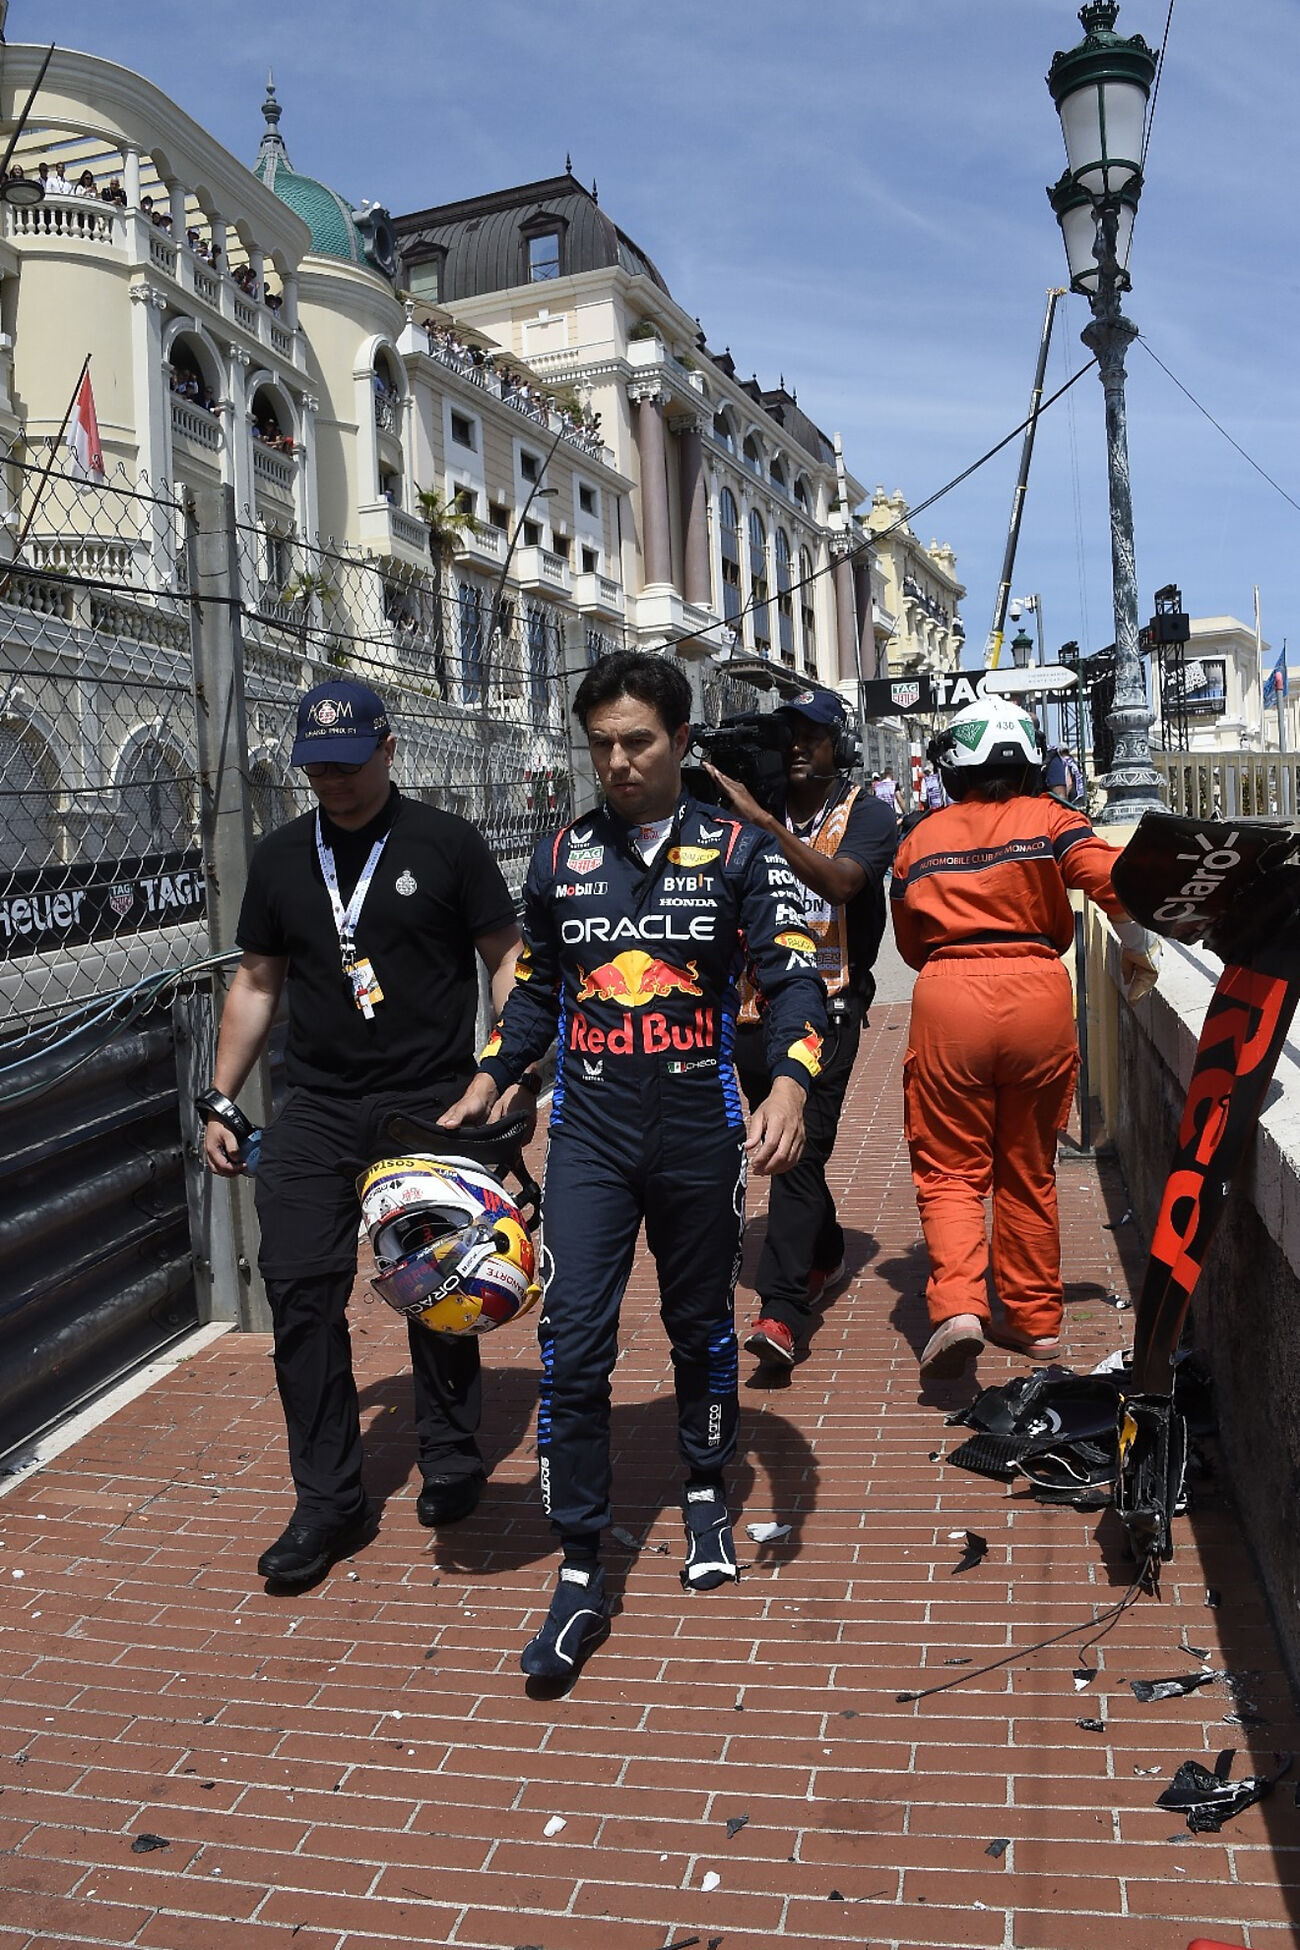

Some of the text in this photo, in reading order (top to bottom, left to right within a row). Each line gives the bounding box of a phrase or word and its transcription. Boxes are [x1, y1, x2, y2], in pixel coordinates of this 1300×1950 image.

[893, 684, 917, 693] TAG
[575, 849, 602, 860] TAG
[920, 857, 970, 870] AUTOMOBILE
[971, 853, 993, 865] CLUB
[1003, 841, 1046, 854] MONACO
[111, 885, 132, 895] TAG
[555, 882, 593, 898] Mobil
[663, 872, 715, 892] BYBIT
[1152, 849, 1241, 922] Claro
[659, 898, 719, 908] HONDA
[561, 914, 717, 944] ORACLE
[570, 1007, 714, 1055] Red Bull
[685, 1058, 717, 1070] CHECO
[708, 1404, 721, 1447] sparco
